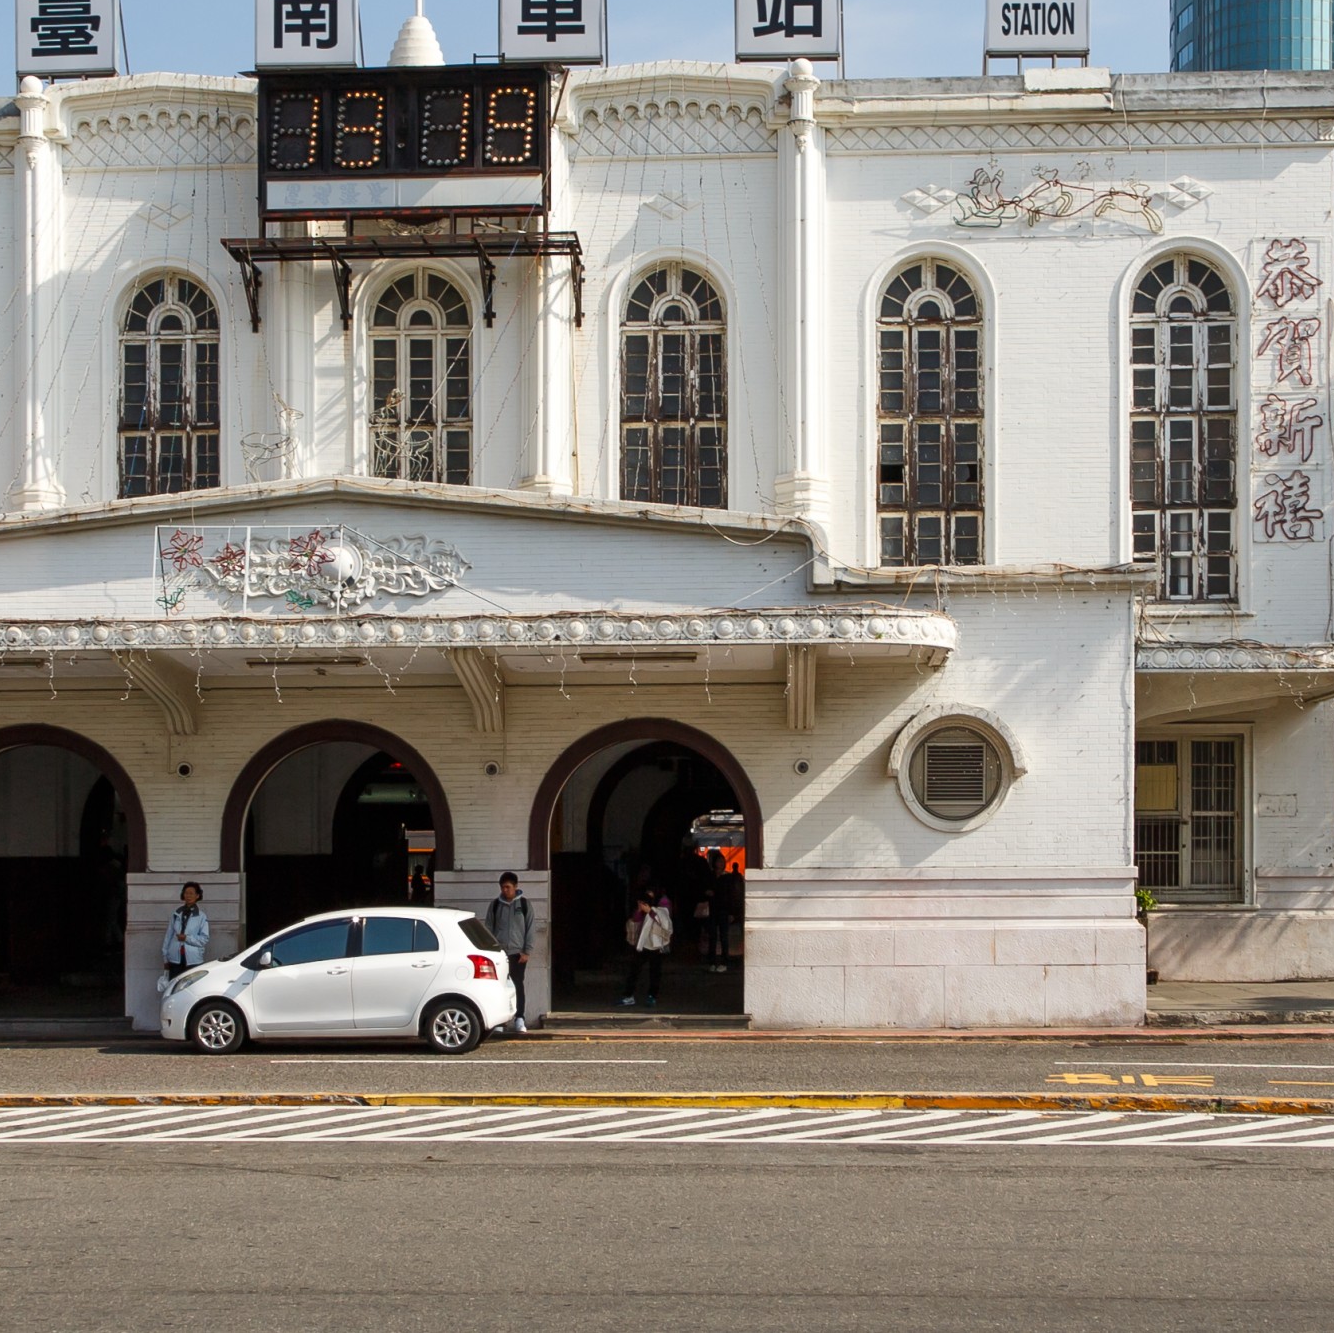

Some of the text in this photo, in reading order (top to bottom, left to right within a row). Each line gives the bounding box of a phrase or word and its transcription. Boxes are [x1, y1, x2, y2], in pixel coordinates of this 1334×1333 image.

[1001, 2, 1076, 36] STATION
[1254, 237, 1324, 543] 恭賀新禧
